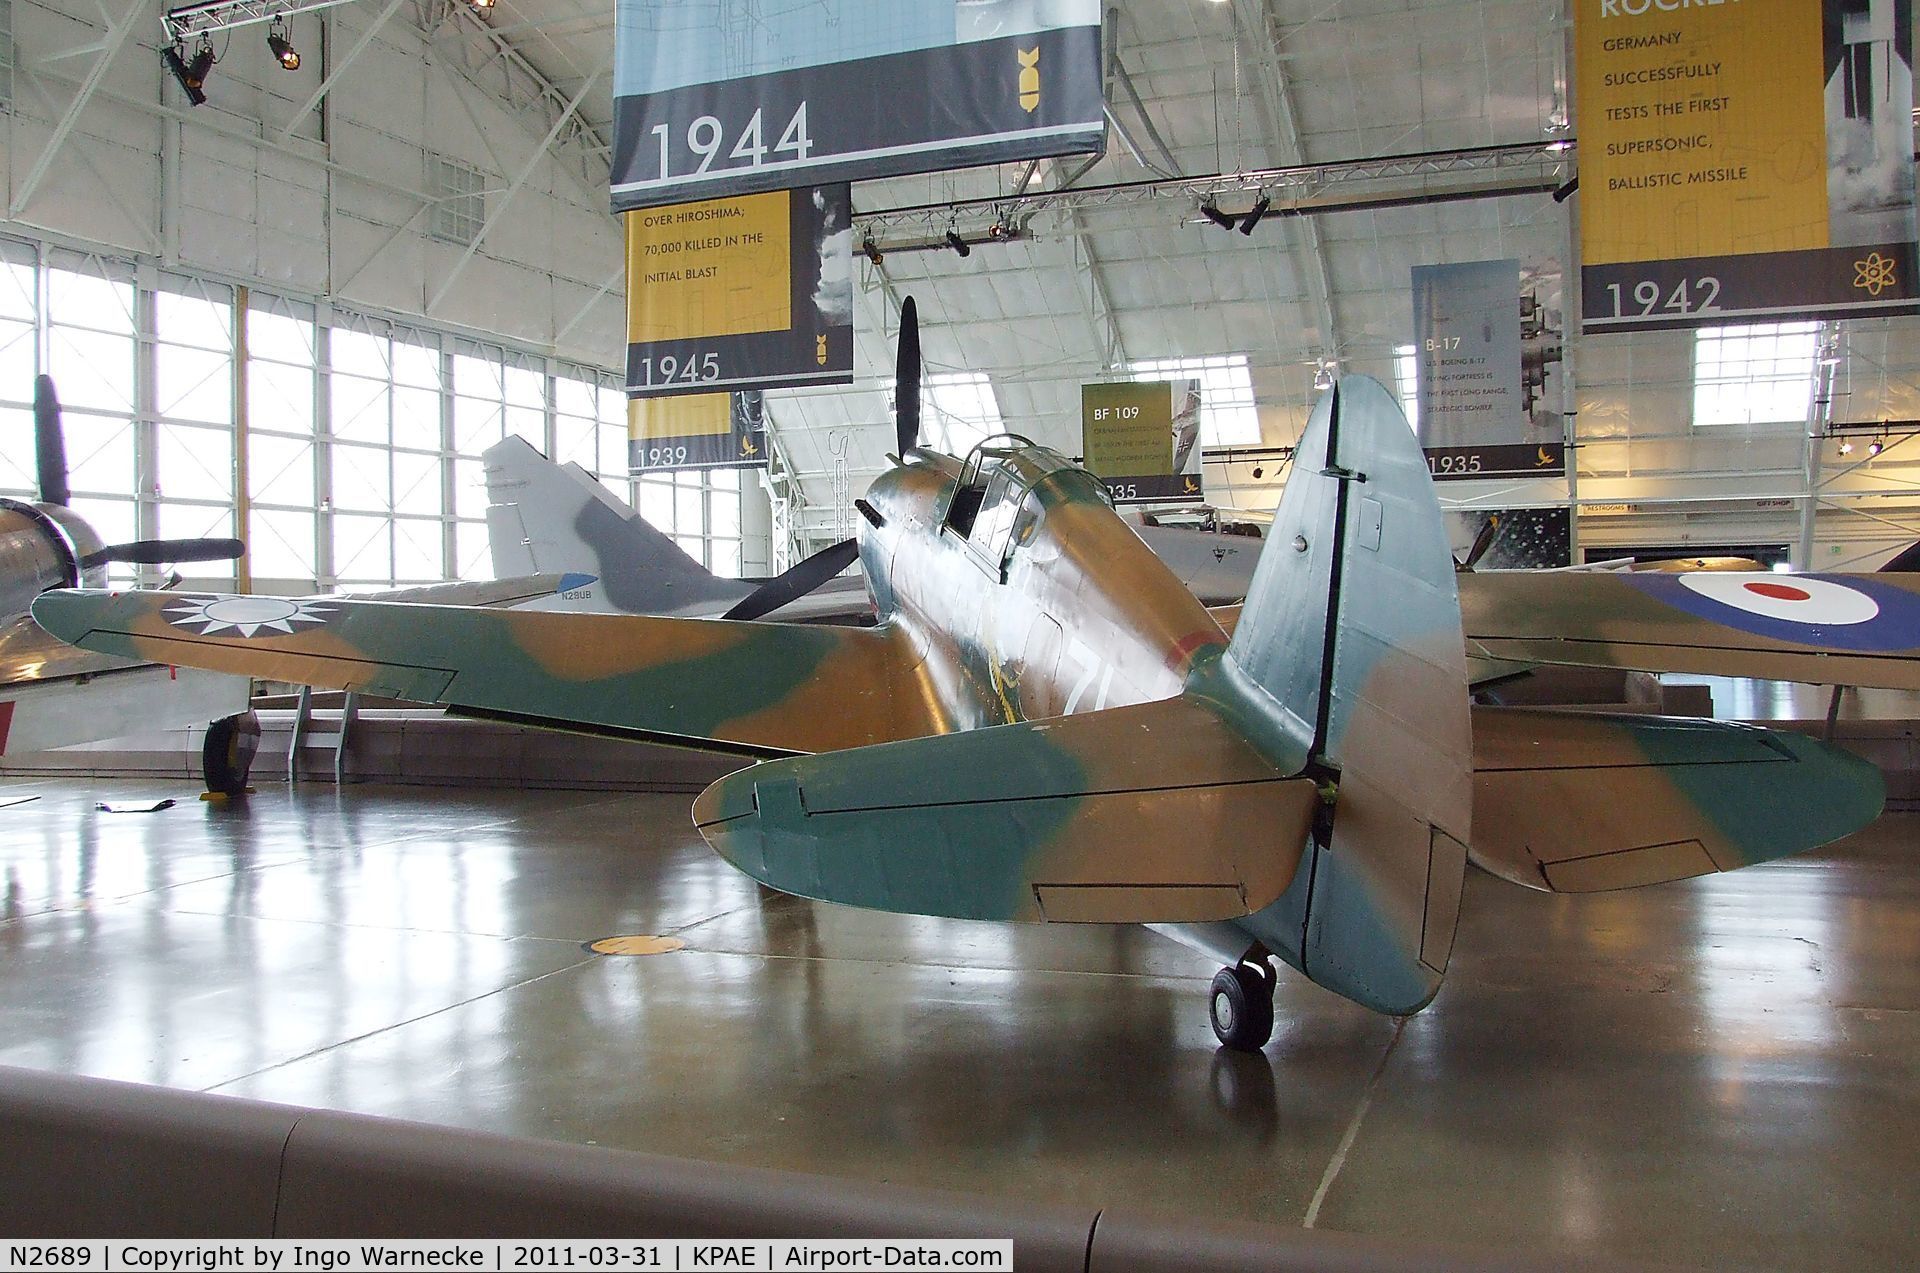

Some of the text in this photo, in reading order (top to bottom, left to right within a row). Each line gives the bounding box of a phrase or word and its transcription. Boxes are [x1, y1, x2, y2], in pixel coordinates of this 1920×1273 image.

[1600, 0, 1739, 18] ROC
[1604, 32, 1682, 51] GERMANY
[1604, 63, 1721, 86] SUCCESSFULLY
[1606, 97, 1730, 121] TESTS THE FIRST
[651, 101, 813, 180] 1944
[1607, 135, 1713, 156] SUPERSONIC,
[1608, 167, 1748, 191] BALLISTIC MISSILE
[644, 207, 745, 228] OVER HIROSHIMA;
[645, 232, 764, 256] 70,000 KILLED IN THE
[644, 266, 718, 284] INITIAL BLAST
[1606, 277, 1721, 317] 1942
[1426, 337, 1461, 351] B-17
[641, 352, 720, 385] 1945
[1452, 373, 1485, 381] FORTRESS
[1094, 406, 1139, 420] BF 109
[638, 446, 687, 466] 1939
[1428, 455, 1482, 473] 1935
[1106, 484, 1137, 499] 35
